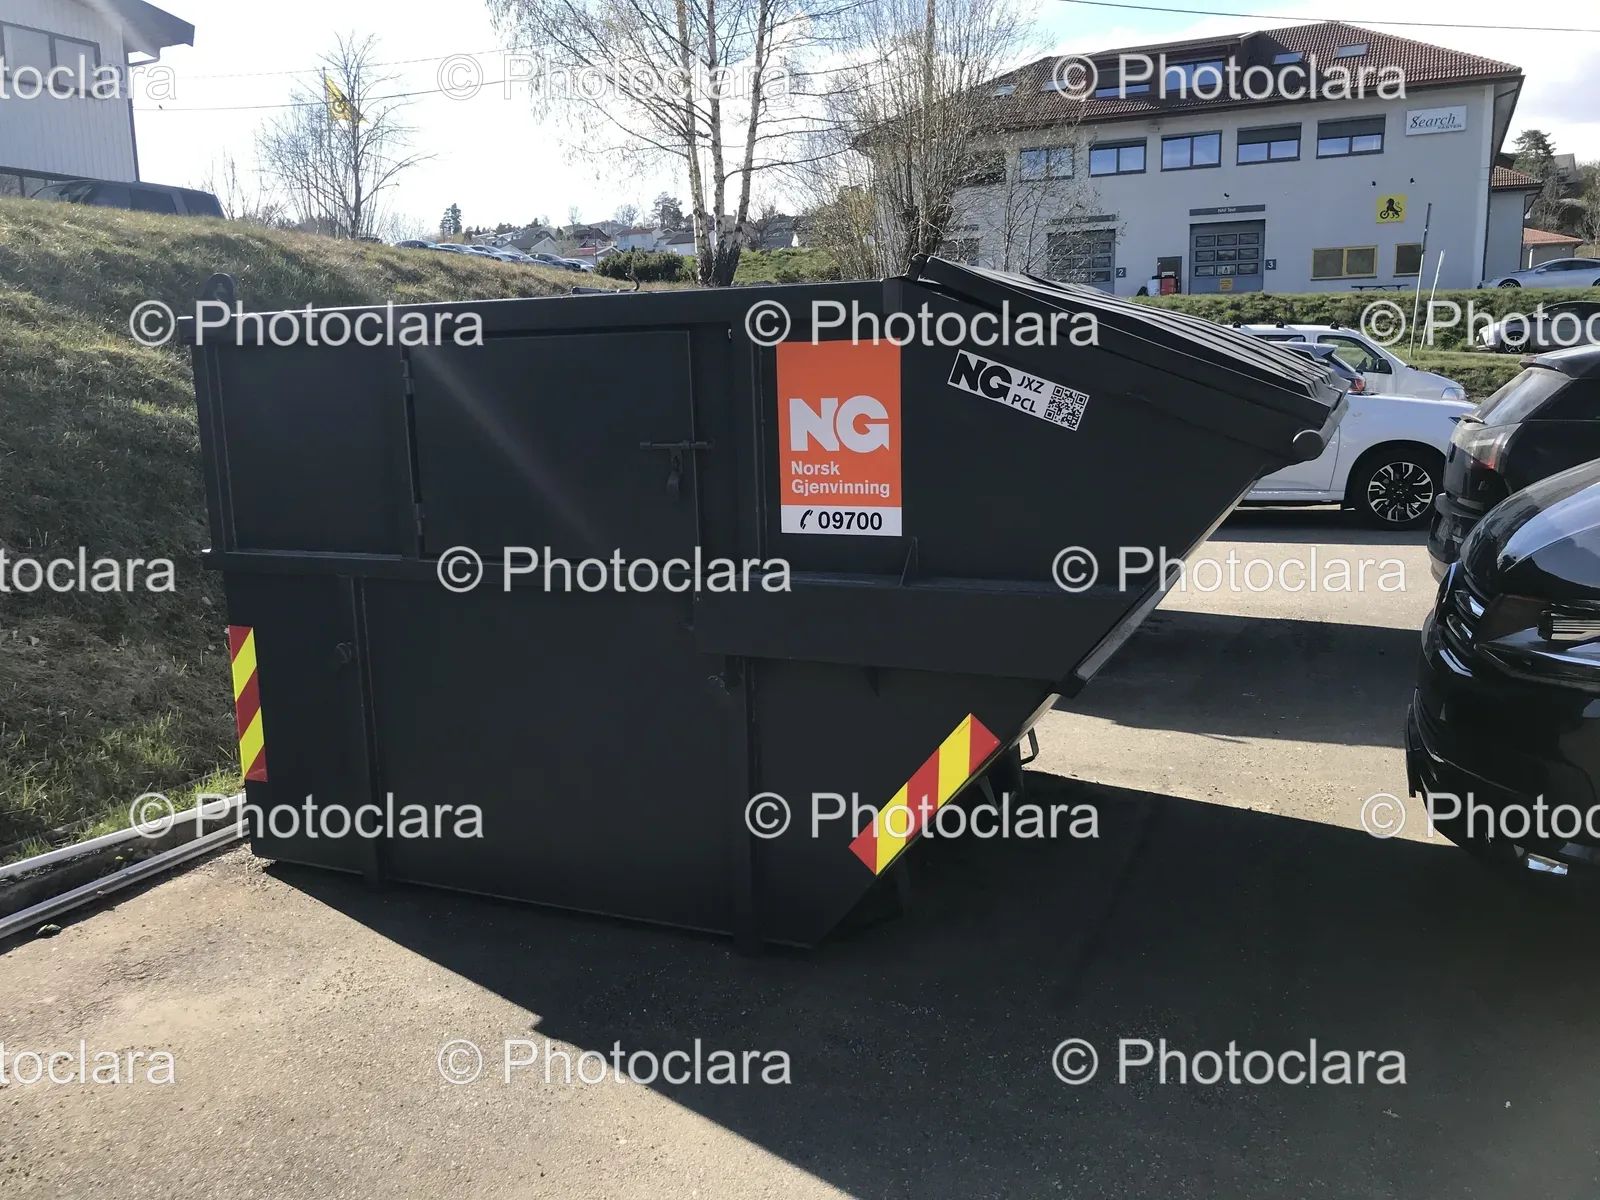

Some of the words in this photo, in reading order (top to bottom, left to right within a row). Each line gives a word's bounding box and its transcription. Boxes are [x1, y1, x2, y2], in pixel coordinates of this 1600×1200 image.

[1410, 112, 1456, 129] Search
[1118, 268, 1124, 277] 2
[1268, 260, 1274, 269] 3
[949, 352, 1012, 402] NG
[1017, 375, 1045, 394] JXZ
[1011, 393, 1036, 413] PCL
[789, 395, 889, 453] NG
[791, 460, 840, 475] Norsk
[791, 478, 890, 498] Gjenvinning
[818, 511, 883, 531] 09700
